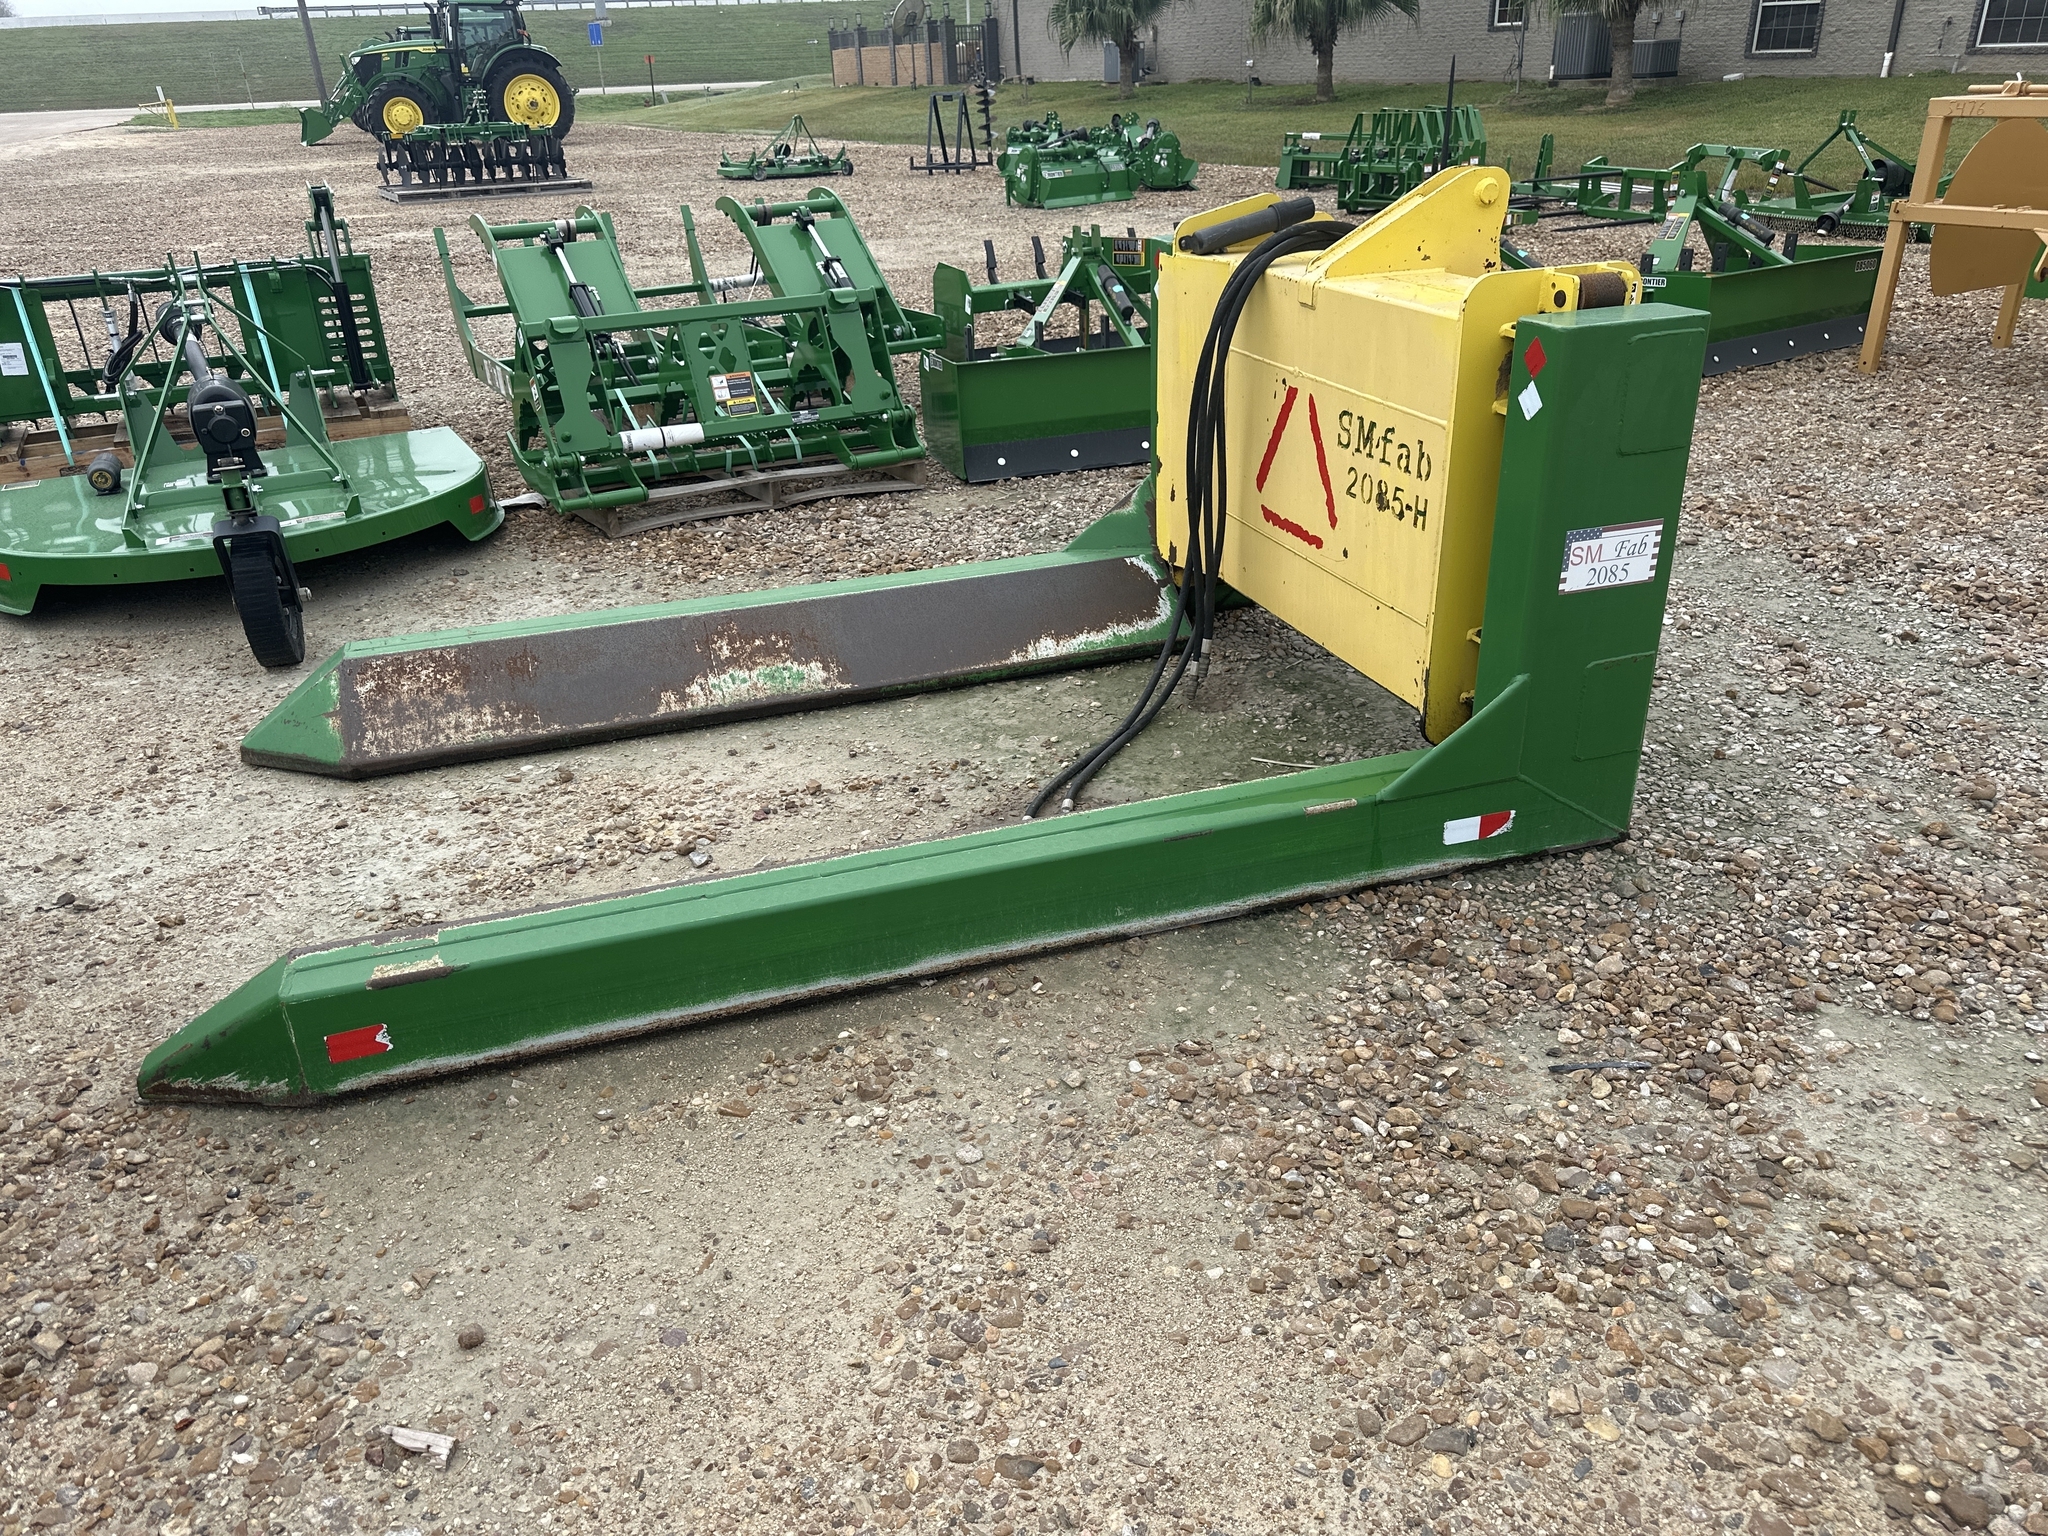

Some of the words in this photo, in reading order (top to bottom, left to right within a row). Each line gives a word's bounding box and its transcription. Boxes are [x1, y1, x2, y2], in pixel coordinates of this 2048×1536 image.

[1337, 409, 1432, 482] SMfab
[1345, 466, 1428, 531] 2085-H
[1570, 543, 1603, 567] SM
[1615, 534, 1649, 558] Fab
[1586, 562, 1630, 587] 2085
